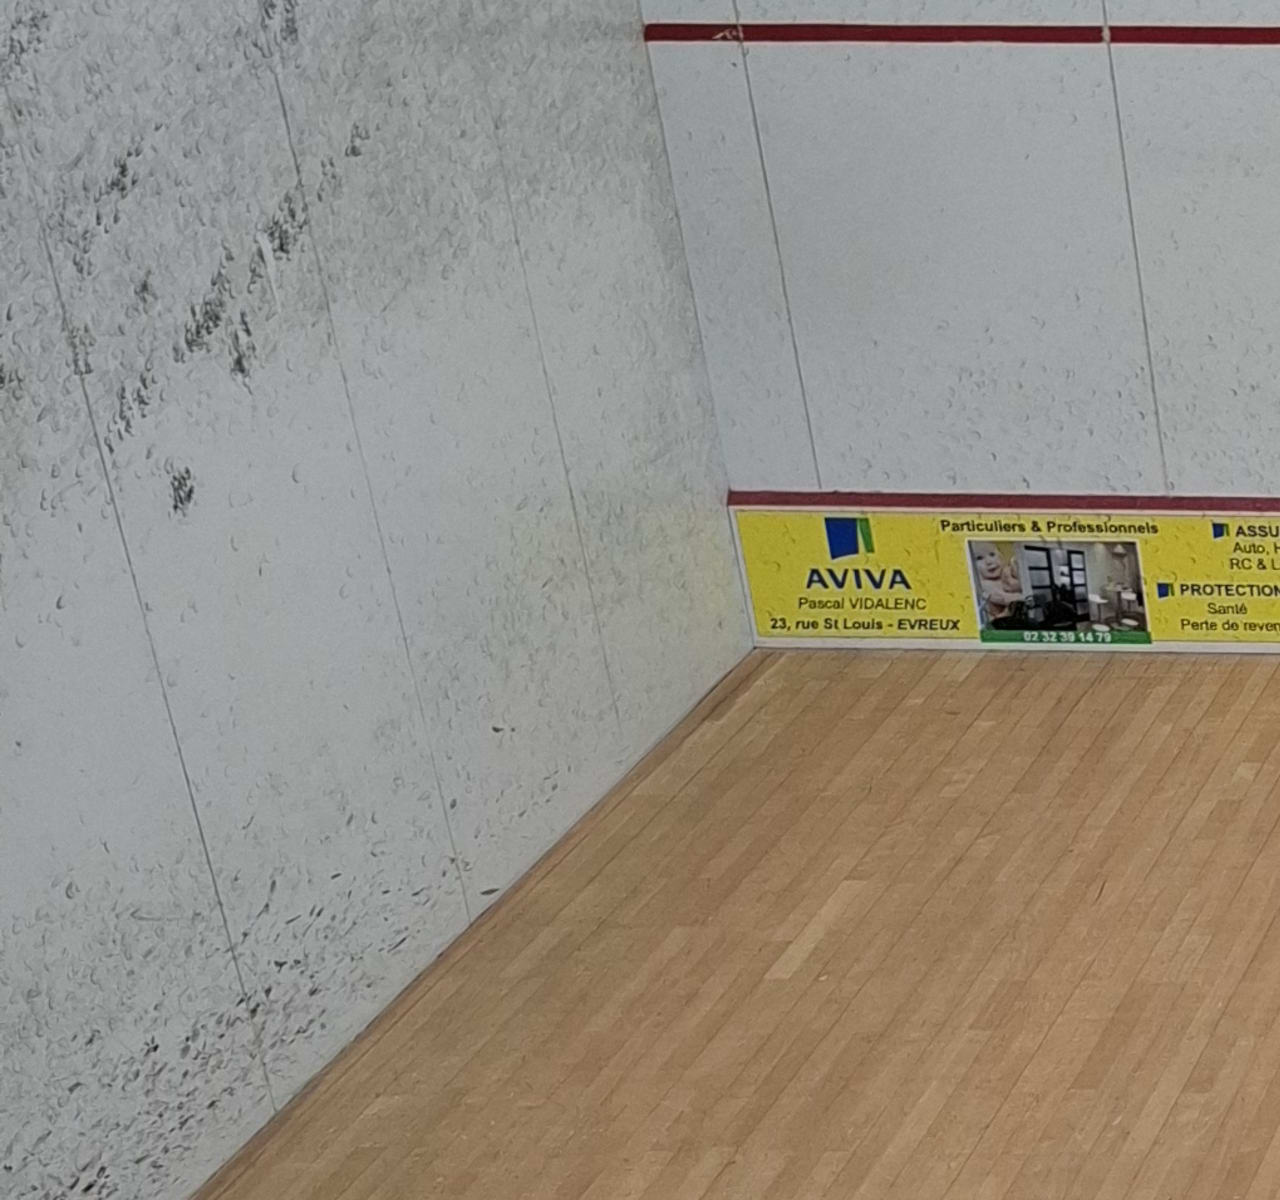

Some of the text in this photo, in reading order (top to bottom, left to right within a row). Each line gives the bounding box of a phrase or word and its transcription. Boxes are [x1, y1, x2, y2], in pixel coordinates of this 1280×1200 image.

[940, 519, 1159, 535] Particuliers & Professionnels
[1233, 541, 1269, 555] Auto,
[1230, 558, 1252, 570] RC
[1257, 558, 1267, 570] &
[806, 568, 912, 590] AVIVA
[798, 597, 927, 610] Pascal VIDALENC
[1207, 602, 1248, 615] Santé
[770, 618, 792, 632] 23,
[795, 620, 819, 630] rue
[823, 618, 838, 630] St
[843, 618, 883, 630] Louis
[897, 618, 960, 631] EVREUX
[1180, 618, 1217, 631] Perte
[1221, 619, 1239, 631] de
[1023, 631, 1040, 642] 02
[1042, 631, 1059, 642] 32
[1079, 631, 1094, 642] 14
[1097, 631, 1111, 642] 79
